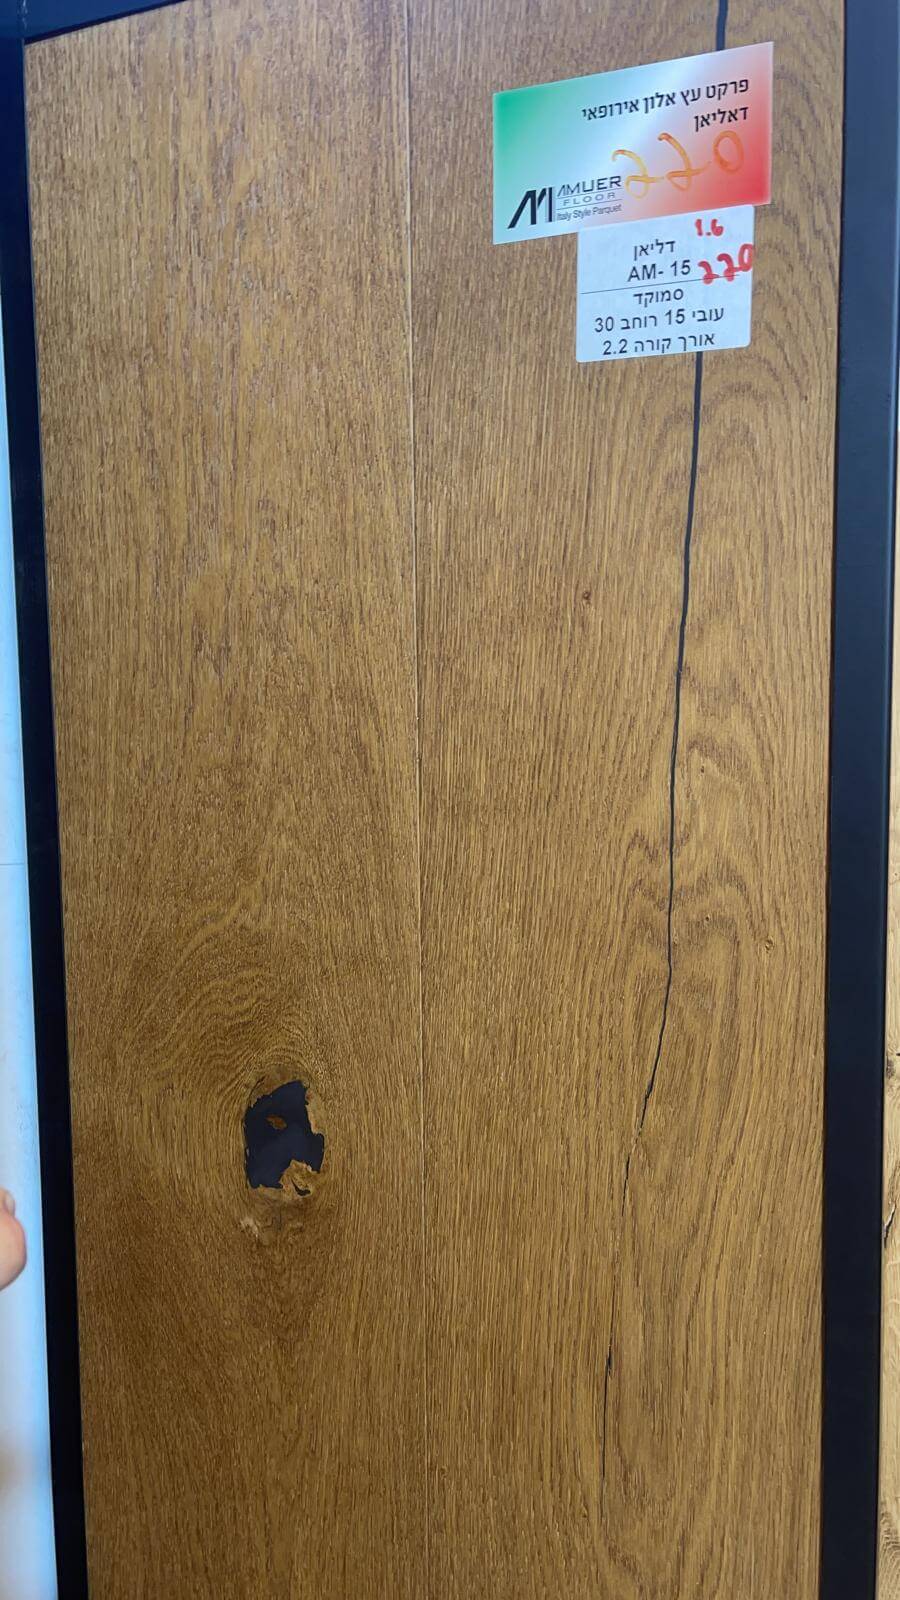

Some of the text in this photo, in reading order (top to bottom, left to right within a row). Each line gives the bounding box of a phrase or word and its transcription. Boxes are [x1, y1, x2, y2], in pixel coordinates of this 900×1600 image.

[581, 79, 749, 121] פרקט עץ אלון אירופאי
[694, 106, 749, 131] דאליאן
[611, 130, 744, 199] 220
[557, 175, 622, 197] AMUER
[562, 191, 616, 207] FLOOR
[556, 204, 622, 222] Italy Style Parquet
[694, 218, 724, 237] 1.6
[633, 238, 676, 261] דליאן
[627, 259, 691, 282] AM- 15
[698, 243, 755, 285] 220
[633, 288, 684, 308] סמוקד
[594, 307, 724, 333] עובי 15 רוחב 30
[602, 333, 715, 356] אורך קורה 2.2
